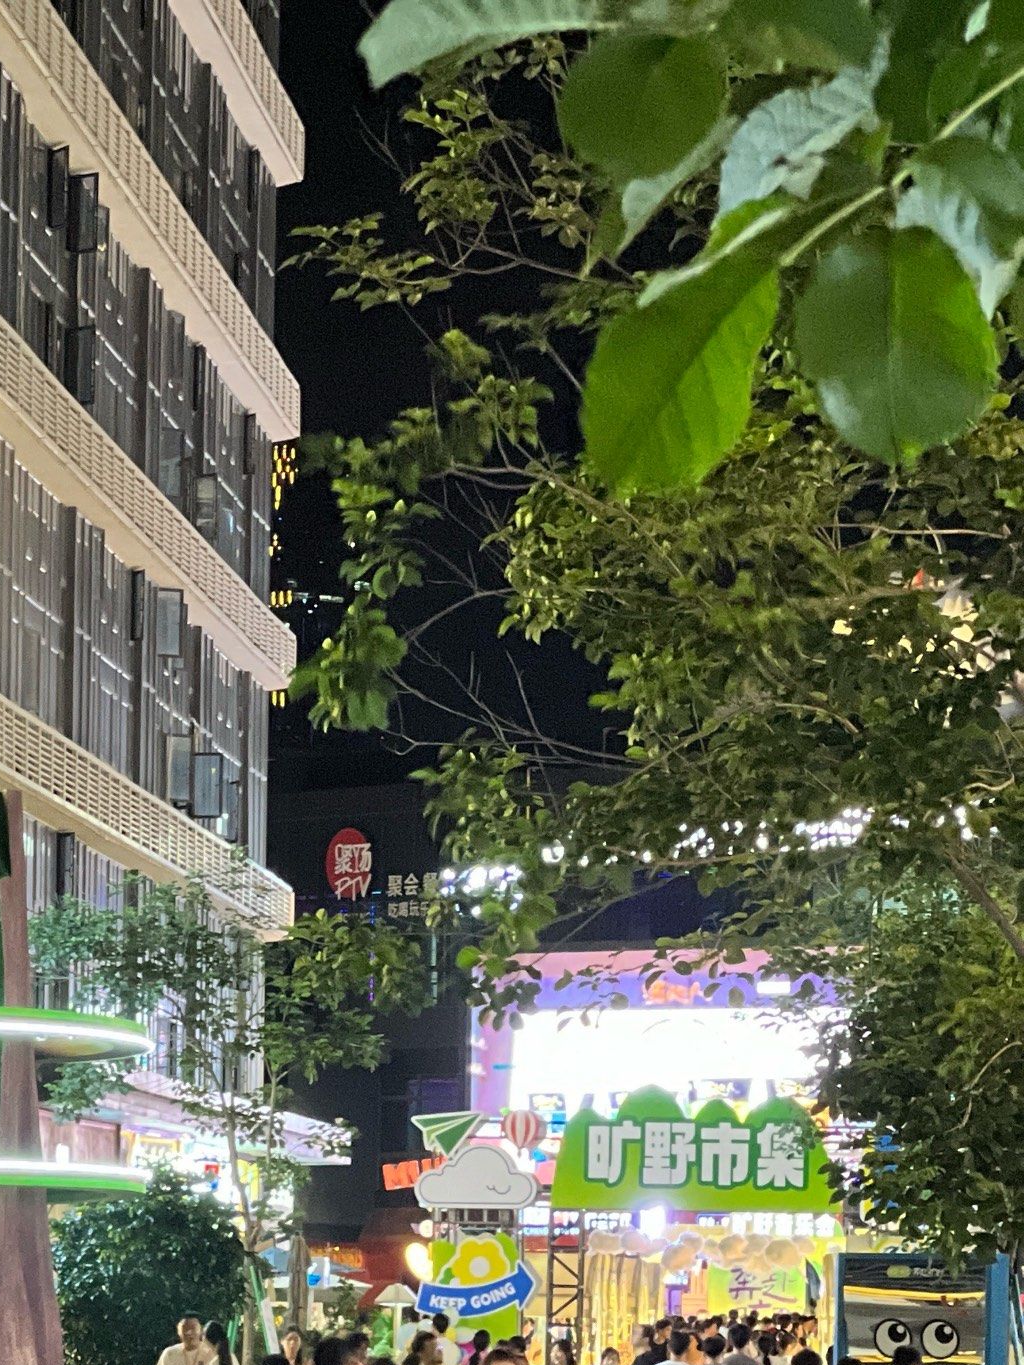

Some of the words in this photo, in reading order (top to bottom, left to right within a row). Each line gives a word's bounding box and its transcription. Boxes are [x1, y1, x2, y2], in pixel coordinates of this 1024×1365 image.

[587, 1120, 804, 1188] 旷野市集
[429, 1294, 467, 1312] KEEP
[470, 1281, 516, 1309] GOING
